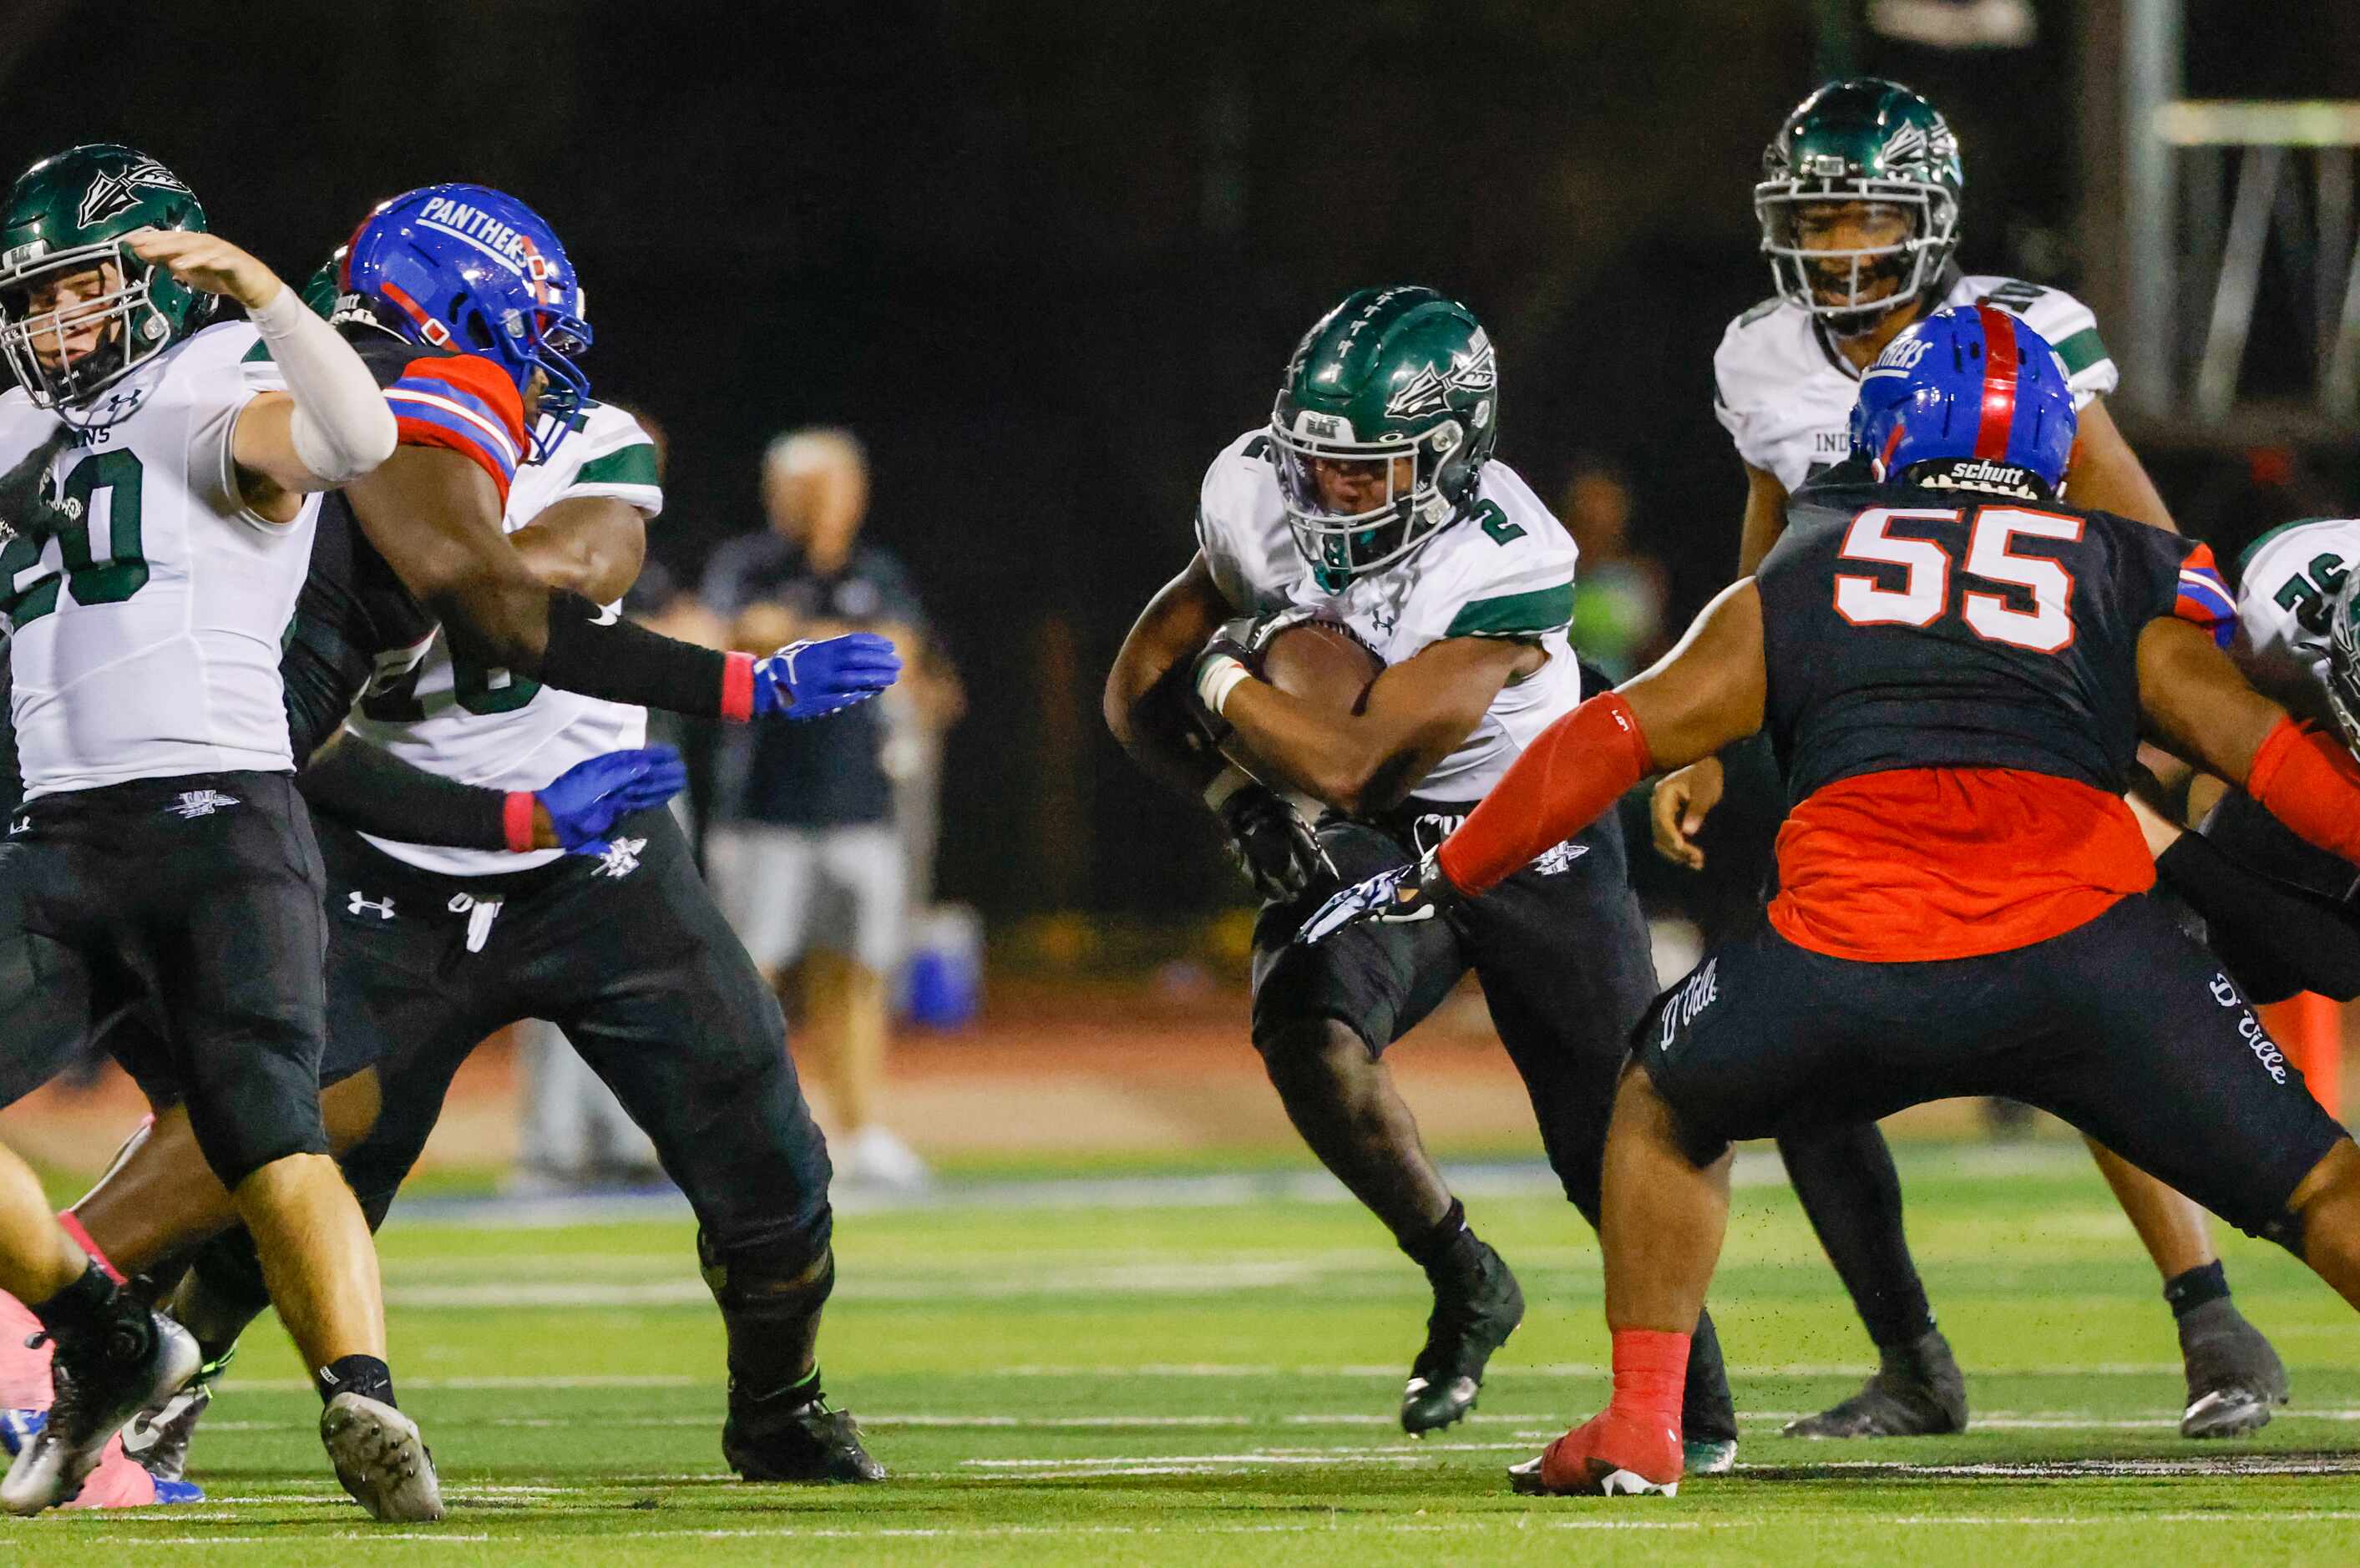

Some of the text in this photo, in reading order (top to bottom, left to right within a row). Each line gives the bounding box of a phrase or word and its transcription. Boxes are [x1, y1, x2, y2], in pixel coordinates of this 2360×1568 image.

[1951, 460, 2024, 485] schutt
[1468, 498, 1528, 547] 2
[1833, 504, 2087, 655] 55
